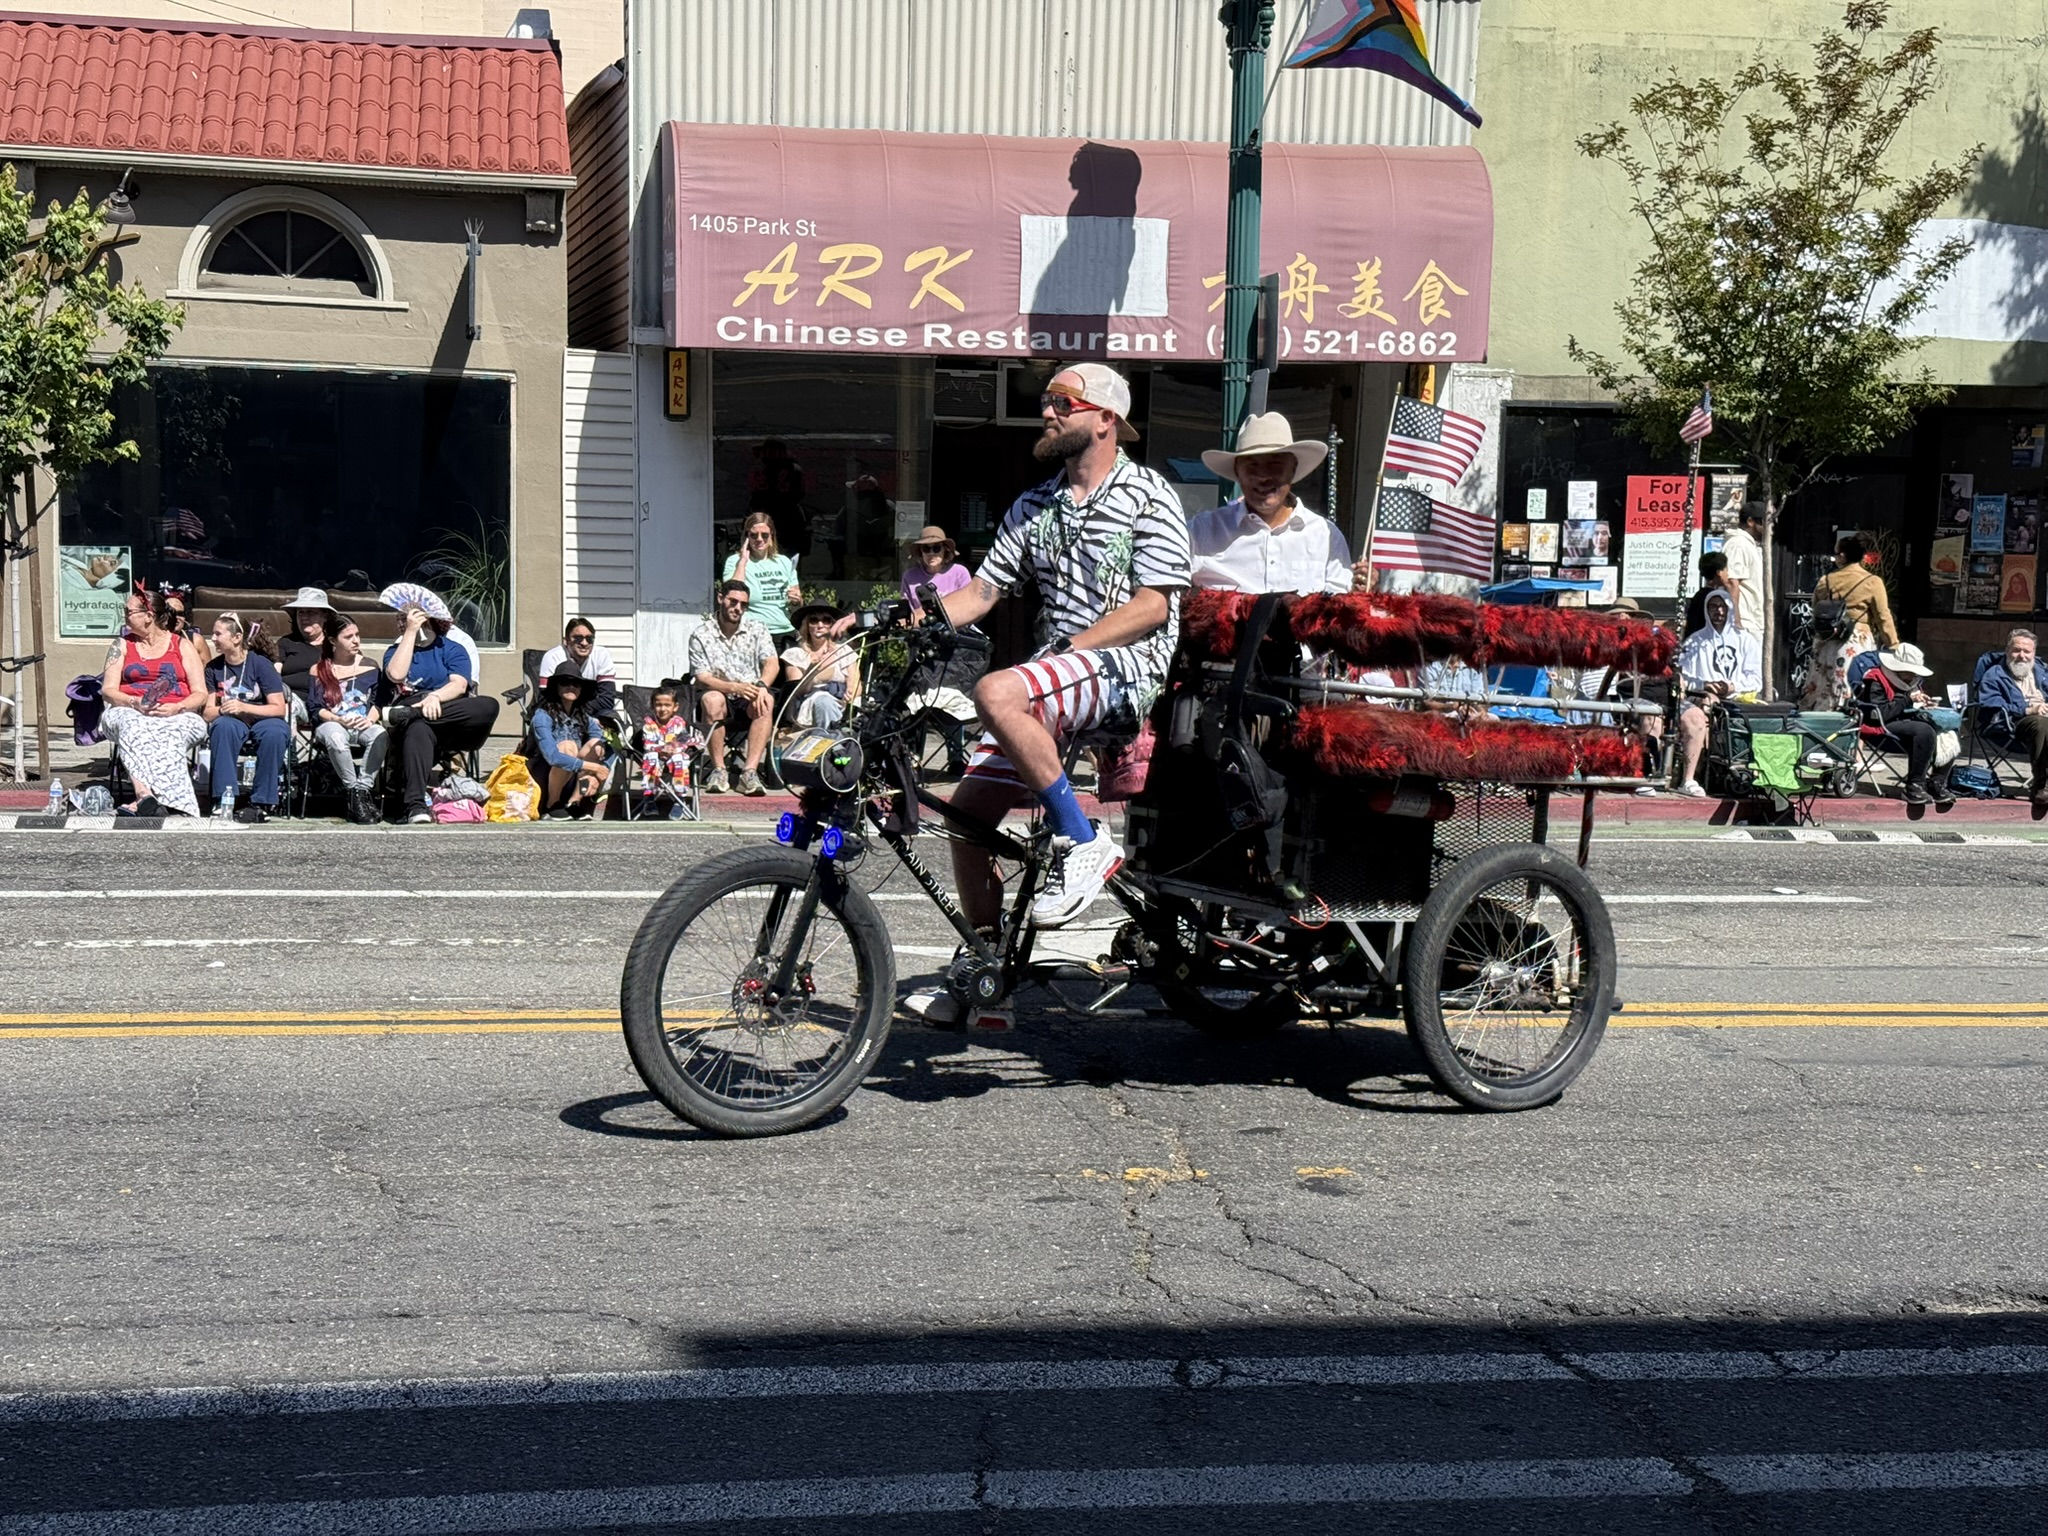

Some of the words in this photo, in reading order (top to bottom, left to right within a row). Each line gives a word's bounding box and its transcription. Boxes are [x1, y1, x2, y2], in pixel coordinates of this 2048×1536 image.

[689, 214, 738, 233] 1405
[744, 217, 791, 236] Park
[795, 219, 817, 237] St
[732, 241, 974, 313] ARK
[716, 316, 908, 347] Chinese
[923, 323, 1178, 352] Restaurant
[1303, 329, 1457, 356] 521-6862
[672, 357, 685, 408] ARK
[1649, 479, 1682, 494] For
[1628, 541, 1654, 550] Justin
[1627, 561, 1643, 570] Jeff
[1644, 561, 1680, 571] Badstub
[64, 600, 125, 611] Hydrafacia
[923, 875, 959, 917] STREET
